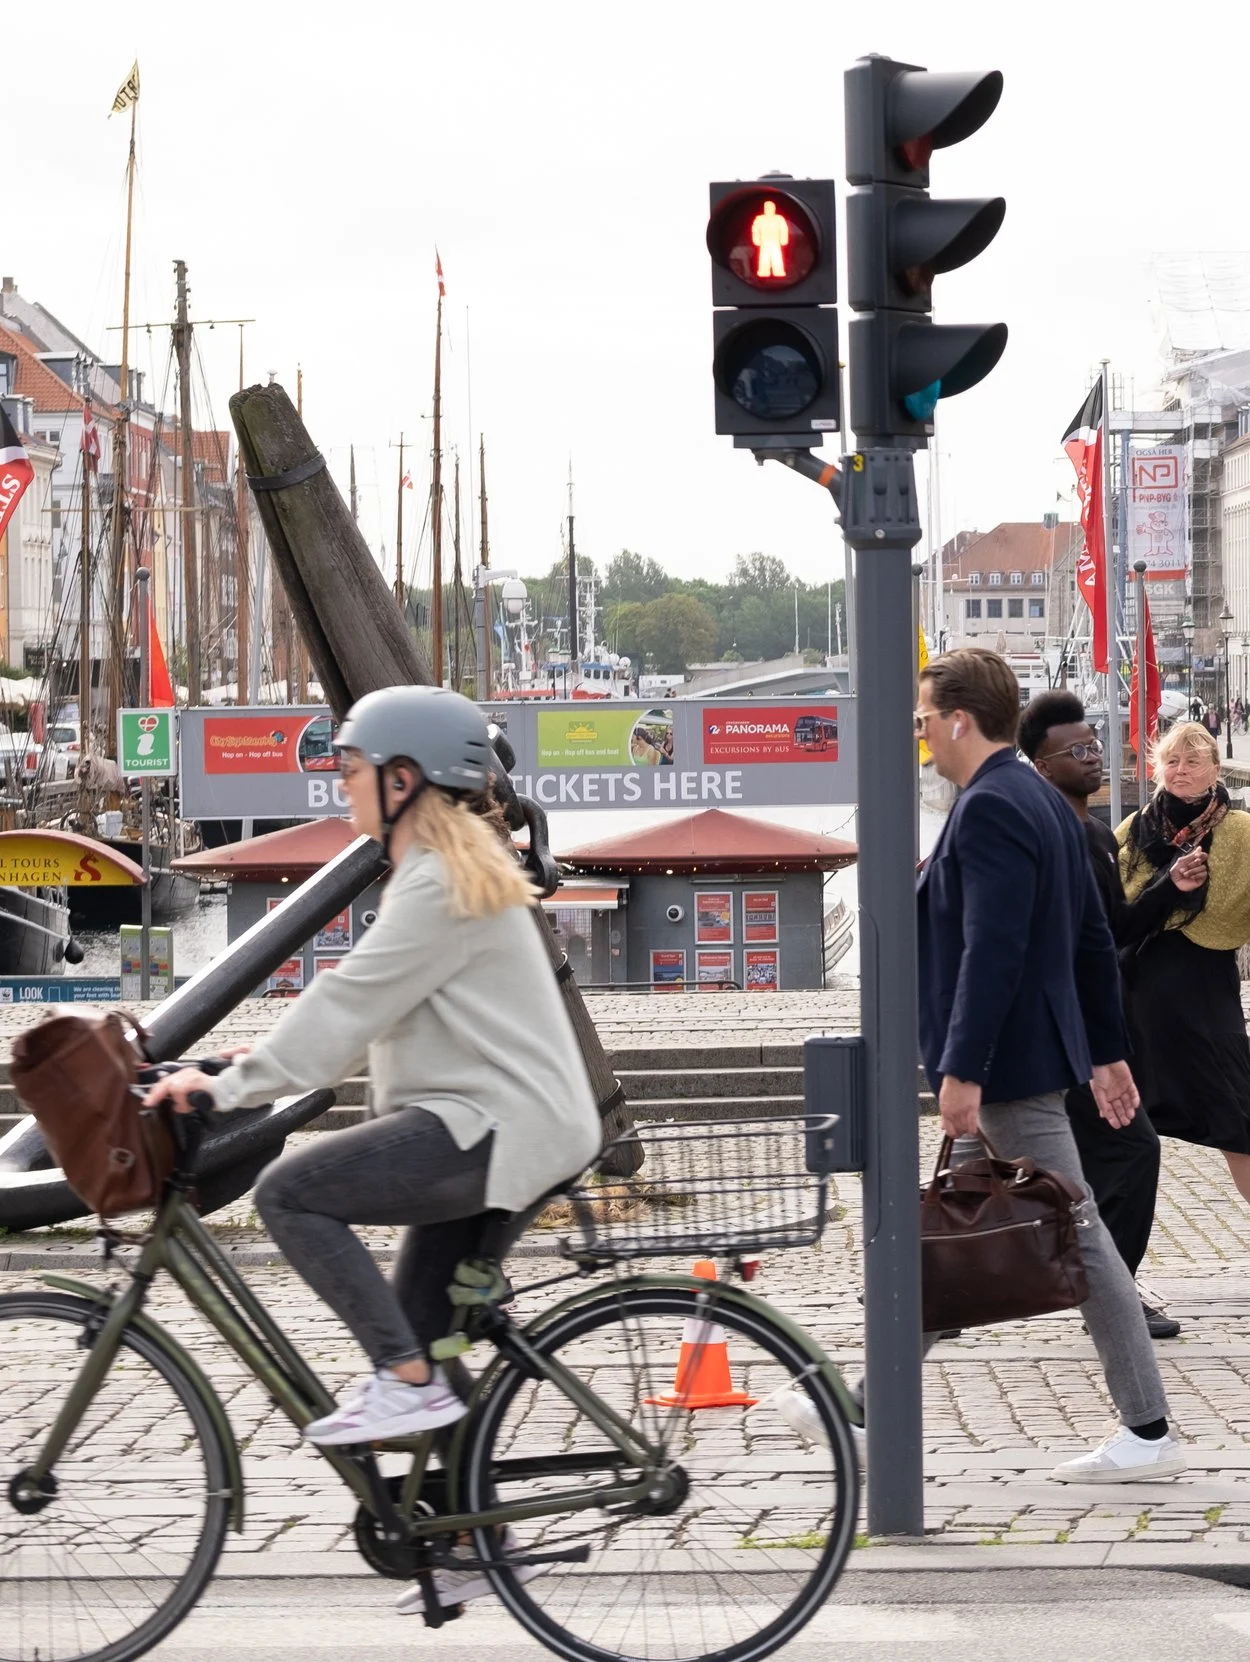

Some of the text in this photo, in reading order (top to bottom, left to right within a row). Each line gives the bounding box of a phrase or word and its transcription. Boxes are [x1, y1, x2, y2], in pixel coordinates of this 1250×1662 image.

[853, 454, 864, 472] 3
[1147, 583, 1174, 595] SGK
[725, 723, 790, 734] PANORAMA
[710, 746, 760, 754] EXCURSIONS
[775, 745, 790, 753] BUS
[125, 758, 169, 767] TOURIST
[308, 779, 352, 808] BU
[654, 771, 743, 801] HERE
[11, 858, 60, 868] TOURS
[19, 986, 44, 1000] LOOK
